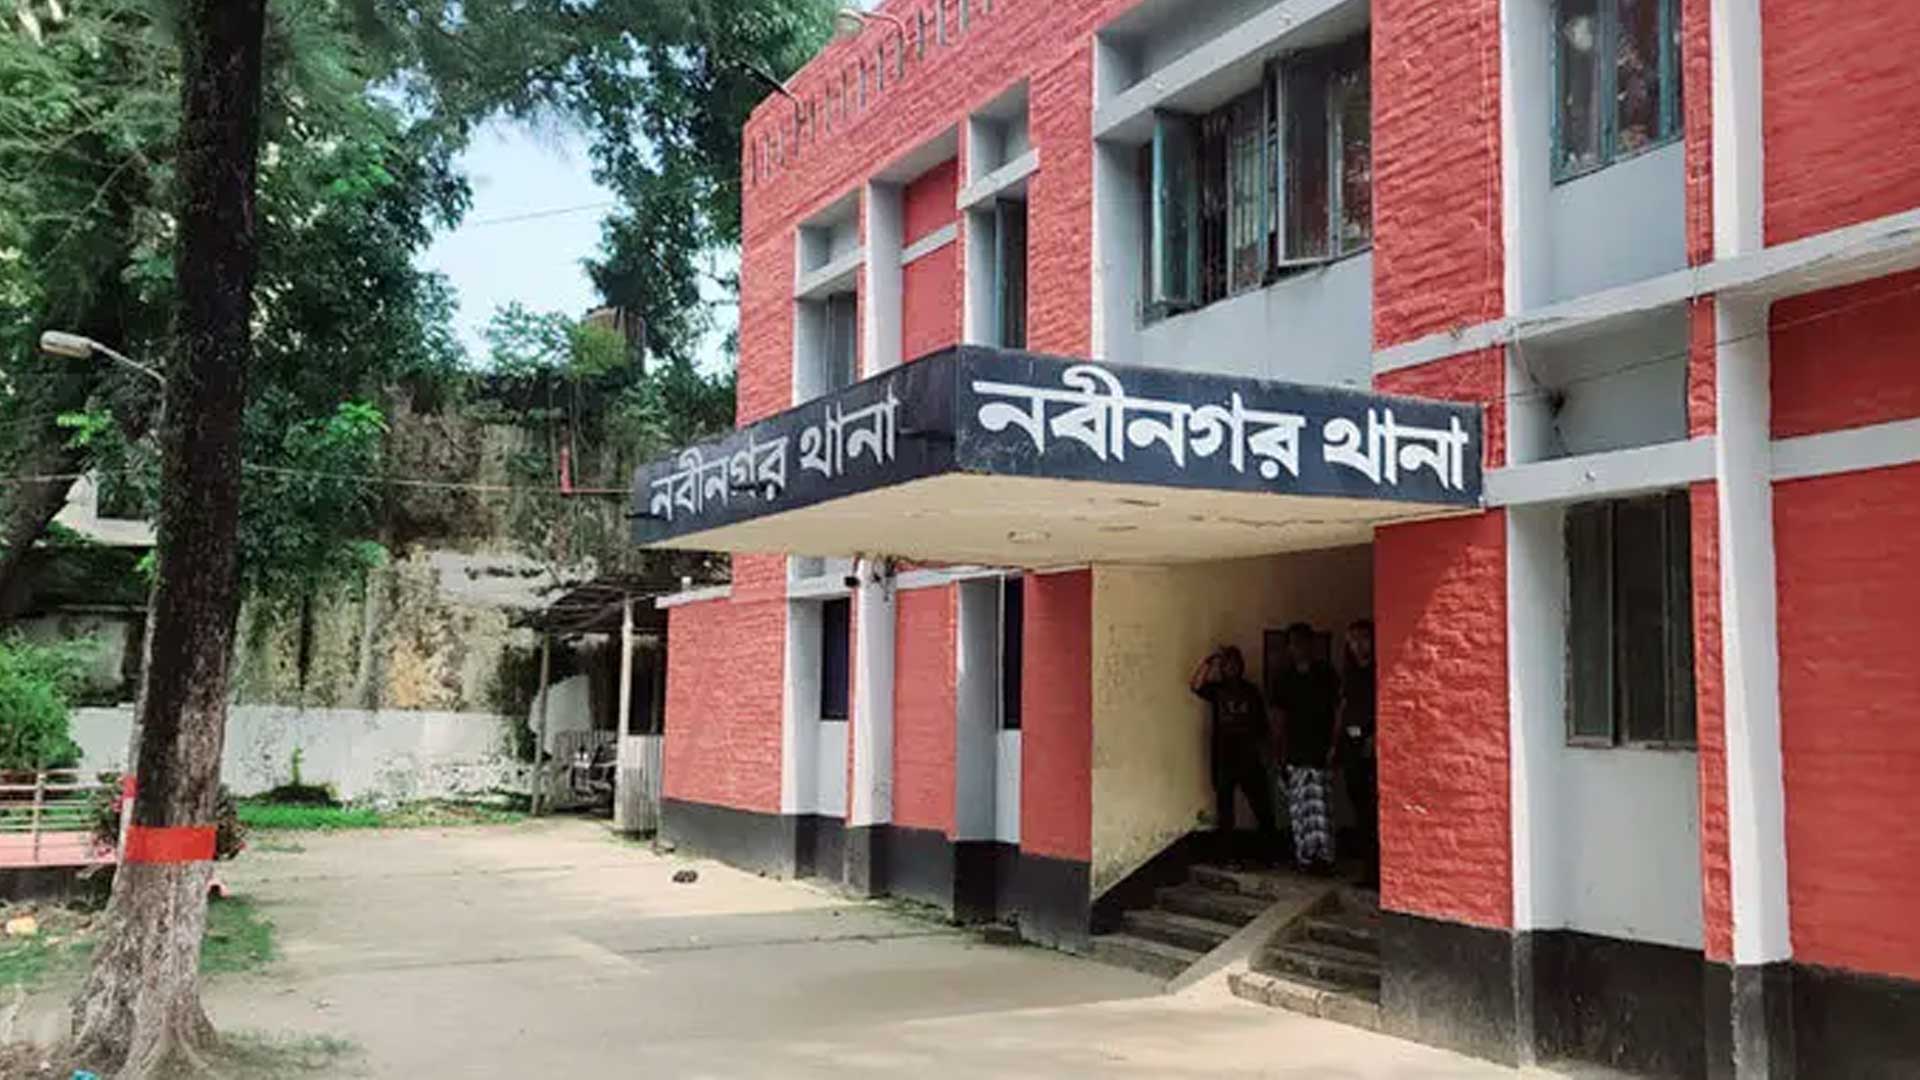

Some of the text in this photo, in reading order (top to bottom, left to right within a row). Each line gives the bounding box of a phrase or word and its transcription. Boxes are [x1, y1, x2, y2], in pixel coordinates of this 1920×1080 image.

[650, 384, 898, 520] নবীনগর থানা
[972, 365, 1469, 491] নবীনগর থানা
